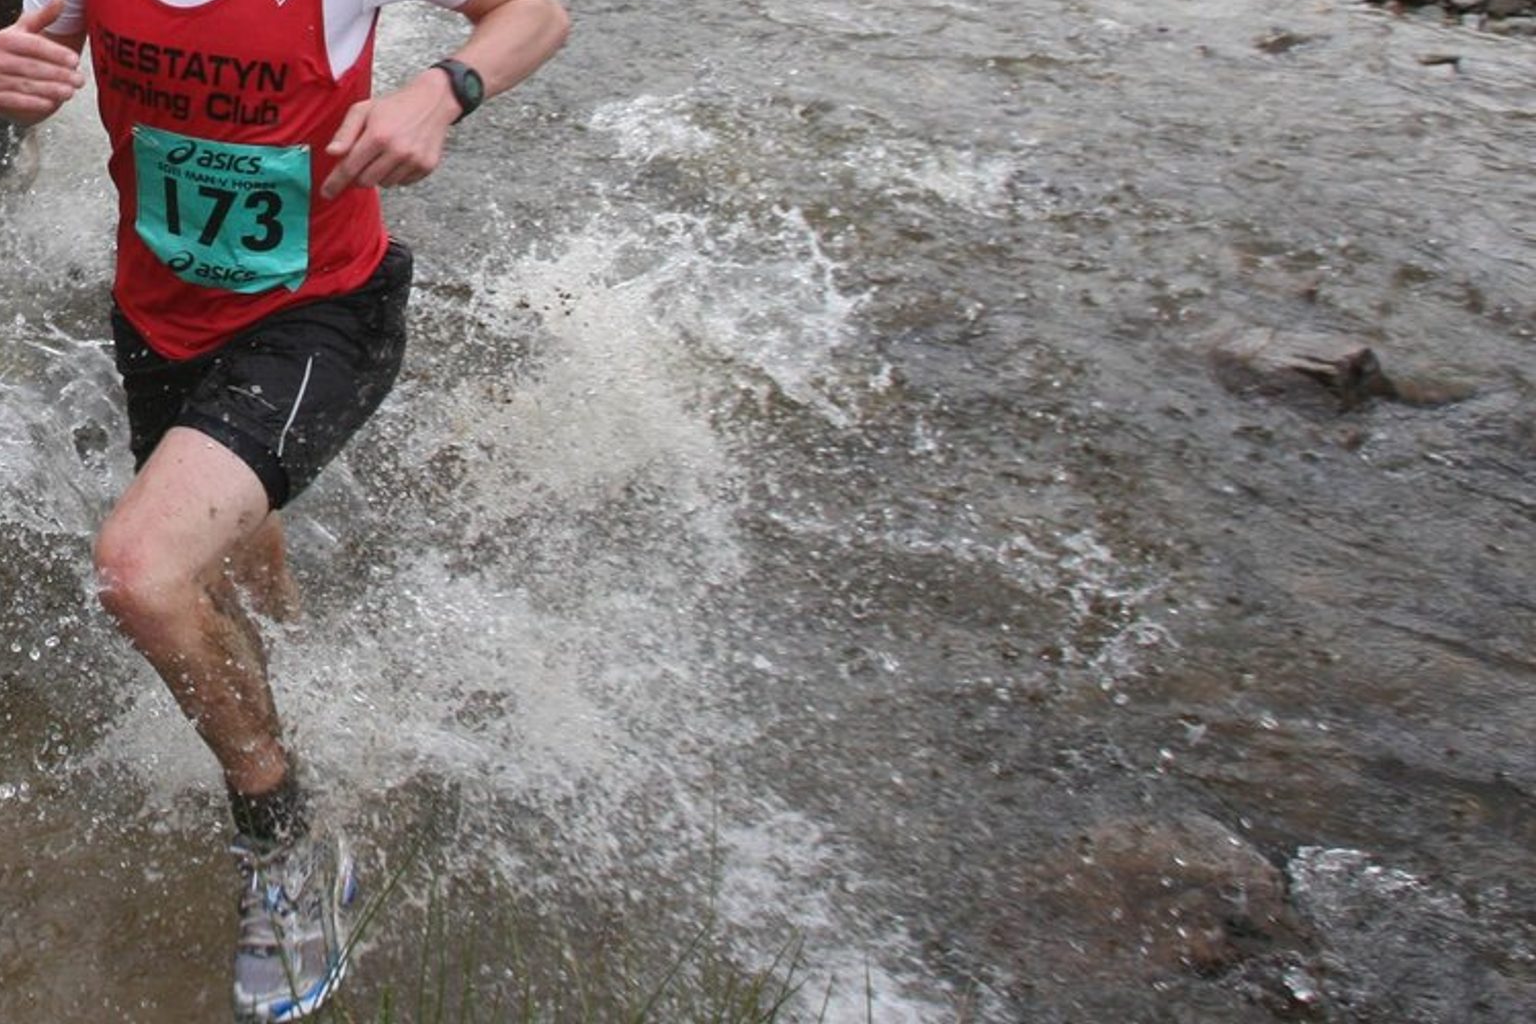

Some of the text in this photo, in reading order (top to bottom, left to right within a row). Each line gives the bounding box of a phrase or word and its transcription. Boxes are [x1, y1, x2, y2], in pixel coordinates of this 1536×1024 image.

[100, 29, 289, 93] RESTATYN
[205, 90, 280, 126] Club
[164, 176, 284, 252] 173
